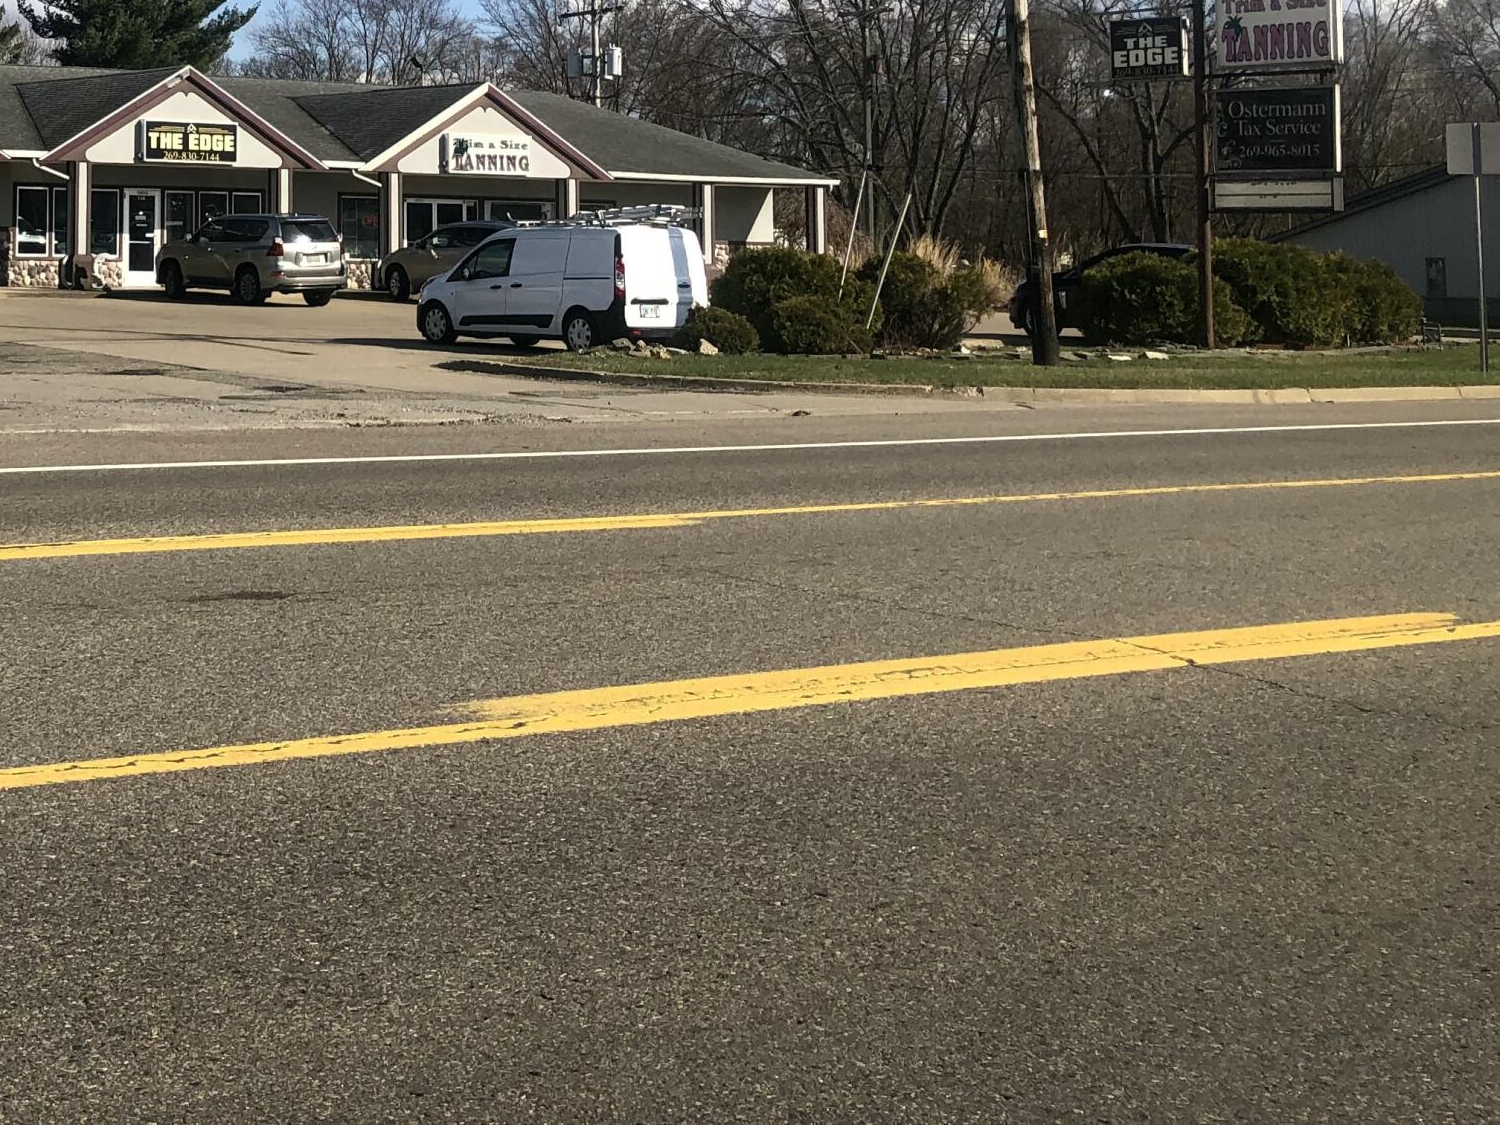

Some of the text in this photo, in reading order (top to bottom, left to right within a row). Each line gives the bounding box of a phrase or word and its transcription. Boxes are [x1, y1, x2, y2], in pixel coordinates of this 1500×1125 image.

[1123, 36, 1168, 50] THE
[1222, 20, 1329, 63] TANNING
[1114, 47, 1179, 68] EDGE
[1228, 101, 1326, 118] Ostermann
[1233, 119, 1321, 136] Tax Service
[148, 132, 235, 152] THE EDGE
[500, 140, 529, 150] Size
[163, 151, 220, 162] 269-830-7144
[1239, 144, 1320, 158] 269-965-8015
[452, 154, 530, 172] TANNING
